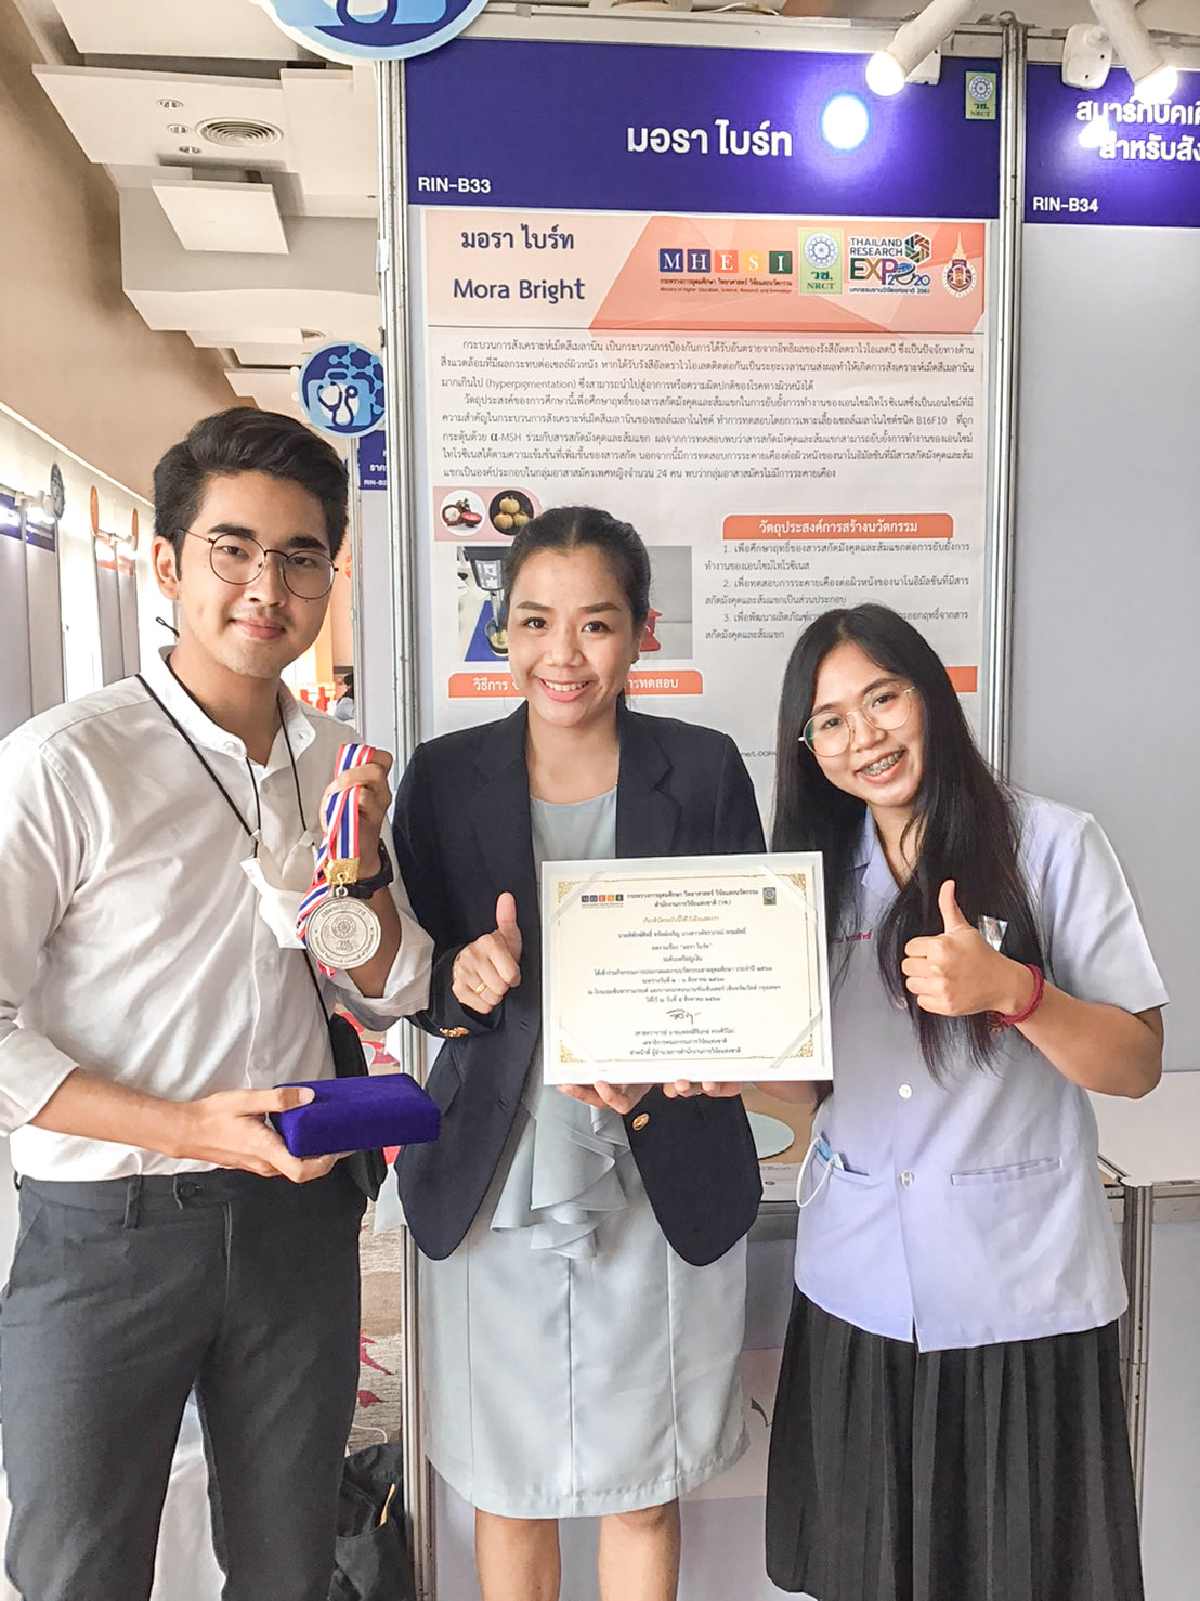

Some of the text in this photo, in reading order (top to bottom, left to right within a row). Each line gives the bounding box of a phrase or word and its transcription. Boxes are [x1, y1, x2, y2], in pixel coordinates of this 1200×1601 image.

[627, 119, 793, 157] มอรา ไบร์ท
[418, 176, 491, 194] RIN-B33
[1032, 197, 1098, 213] RIN-B34
[461, 223, 575, 250] มอรา ไบร์ท
[850, 237, 902, 247] THAILAND
[850, 247, 903, 257] RESEARCH
[810, 271, 833, 281] วช.
[454, 277, 586, 304] Mora Bright
[806, 282, 836, 290] NRCT
[486, 379, 577, 391] (hyperpigmentation)
[758, 518, 918, 537] วัตถุประสงค์การสร้างนวัตกรรม
[723, 545, 732, 555] 1.
[722, 579, 731, 588] 2.
[723, 613, 731, 622] 3.
[473, 677, 508, 692] วิธีการ
